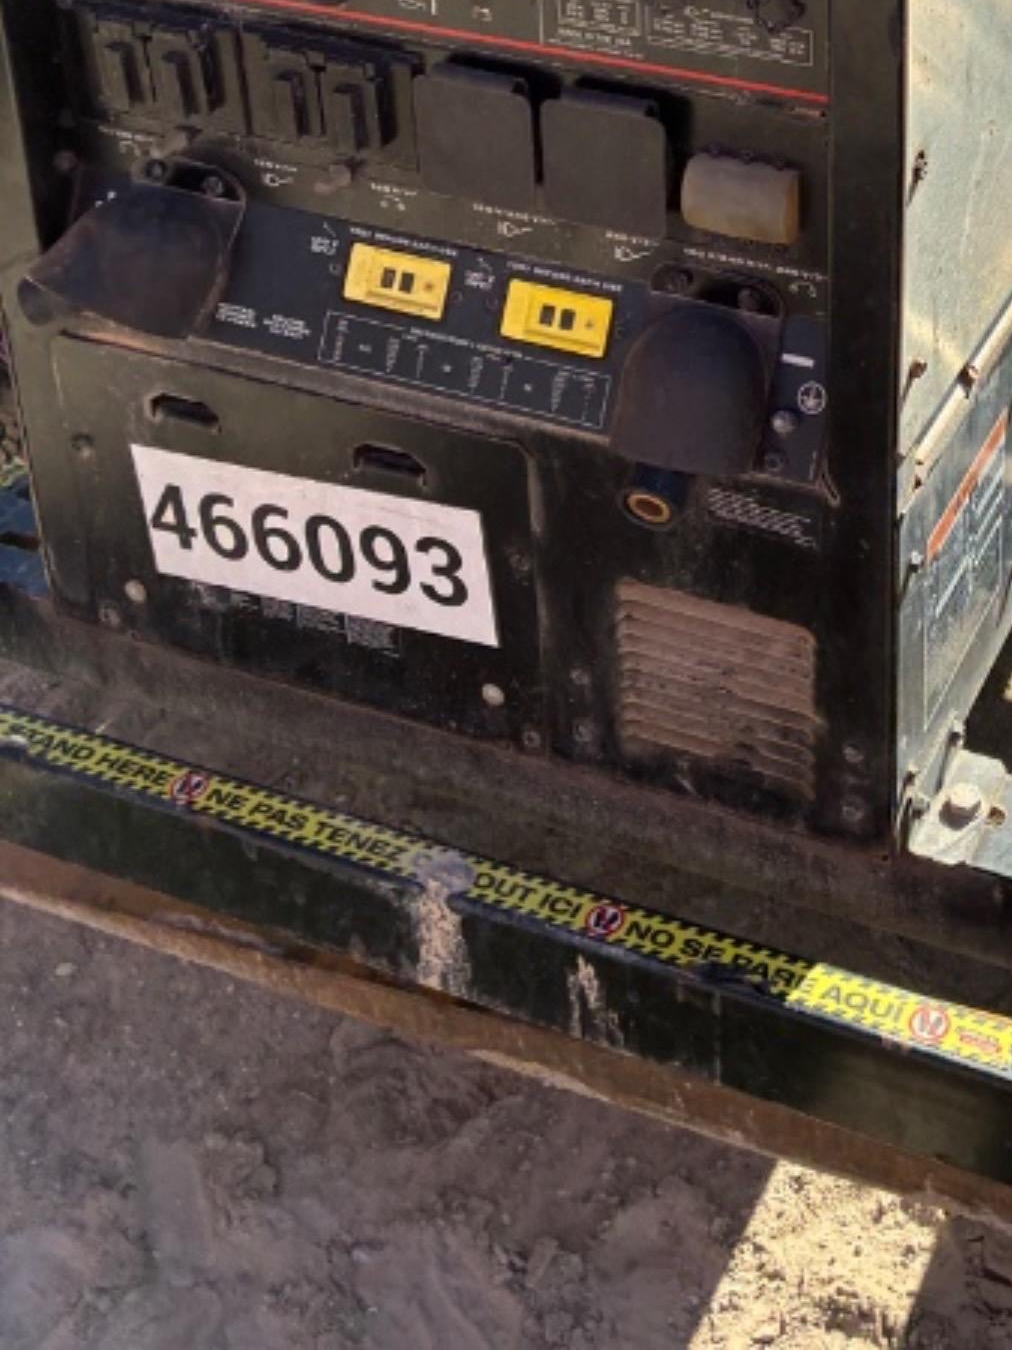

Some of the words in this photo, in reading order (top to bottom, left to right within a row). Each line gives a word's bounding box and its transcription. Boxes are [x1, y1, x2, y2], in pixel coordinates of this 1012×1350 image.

[149, 483, 469, 608] 466093
[96, 751, 173, 788] HERE
[205, 786, 247, 813] NE
[248, 801, 310, 831] PAS
[314, 819, 404, 862] TENEZ
[538, 893, 585, 919] ICI
[625, 920, 676, 949] NO
[680, 936, 727, 962] SE
